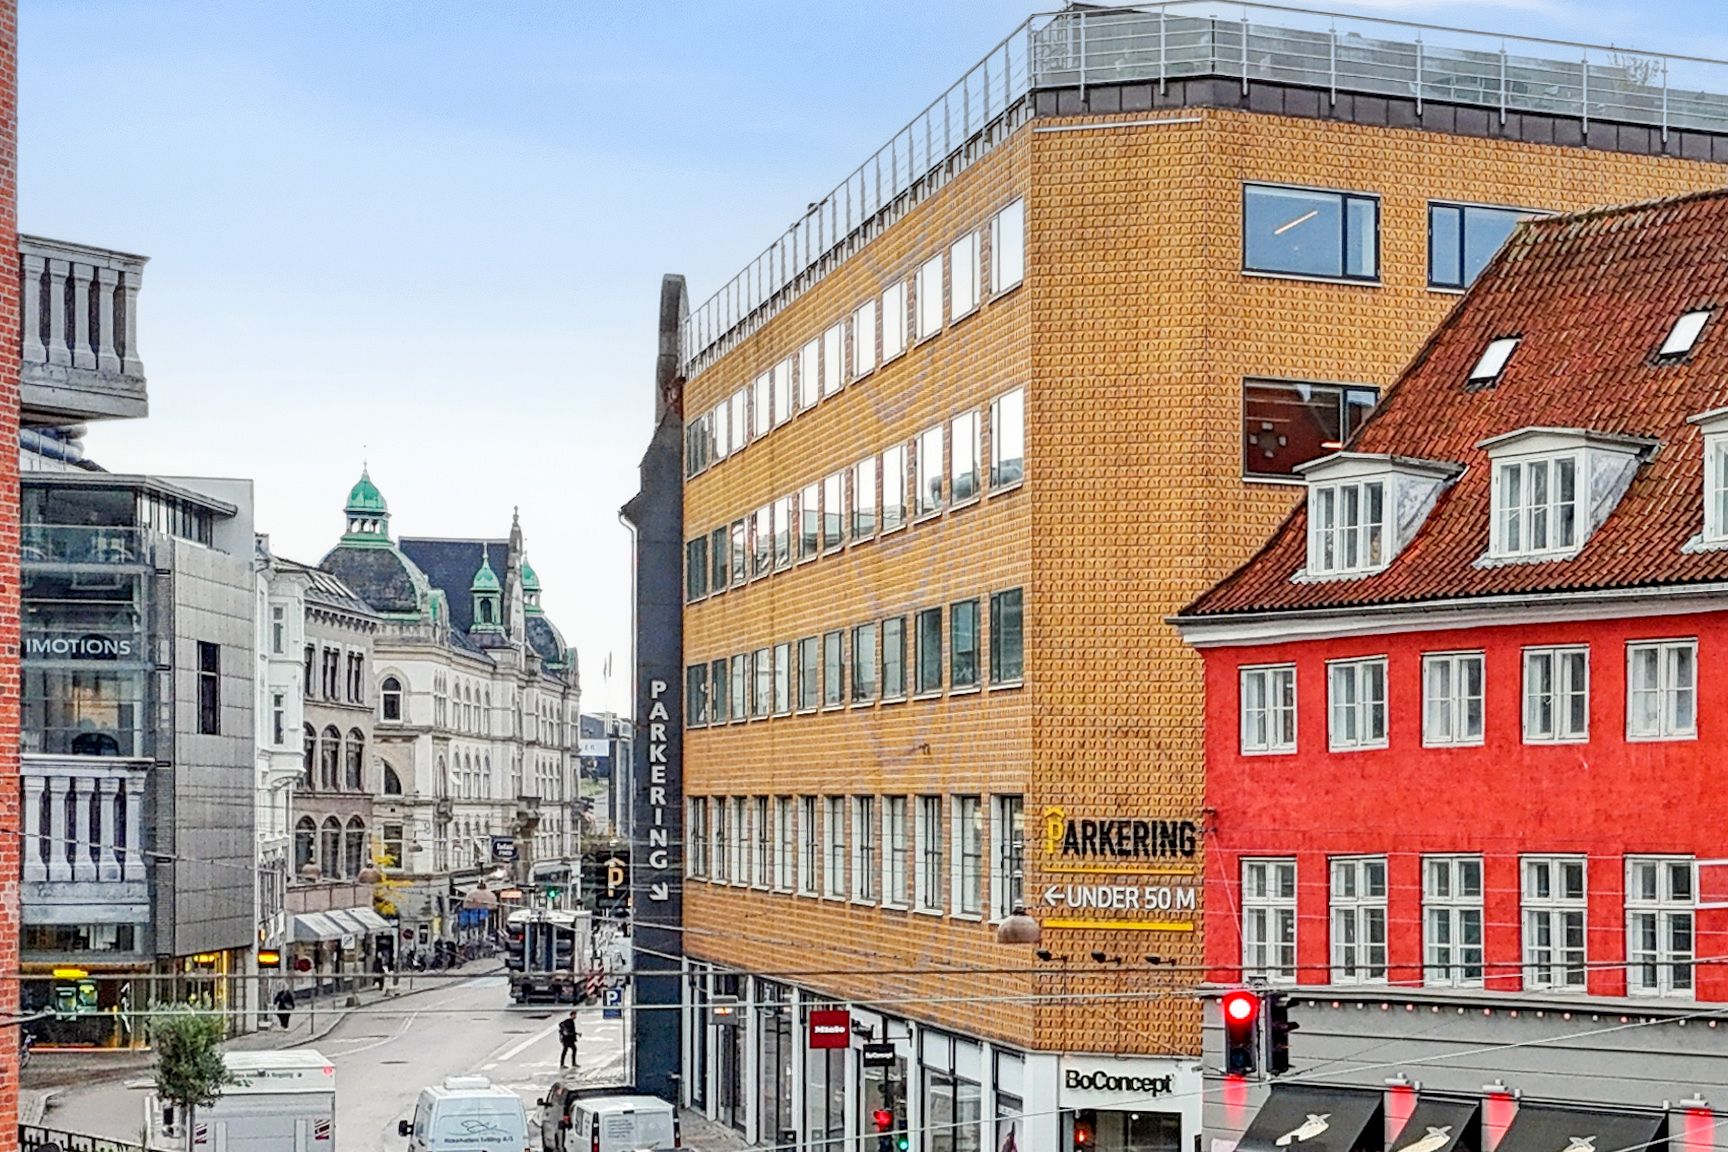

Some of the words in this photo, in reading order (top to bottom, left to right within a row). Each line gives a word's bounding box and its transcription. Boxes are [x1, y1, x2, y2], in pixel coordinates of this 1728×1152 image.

[26, 638, 131, 655] IMOTIONS
[649, 680, 670, 869] PARKERING
[1046, 819, 1197, 857] PARKERING
[1067, 885, 1140, 909] UNDER
[1145, 887, 1172, 910] 50
[1176, 887, 1196, 910] M
[1065, 1069, 1174, 1098] BoConcept
